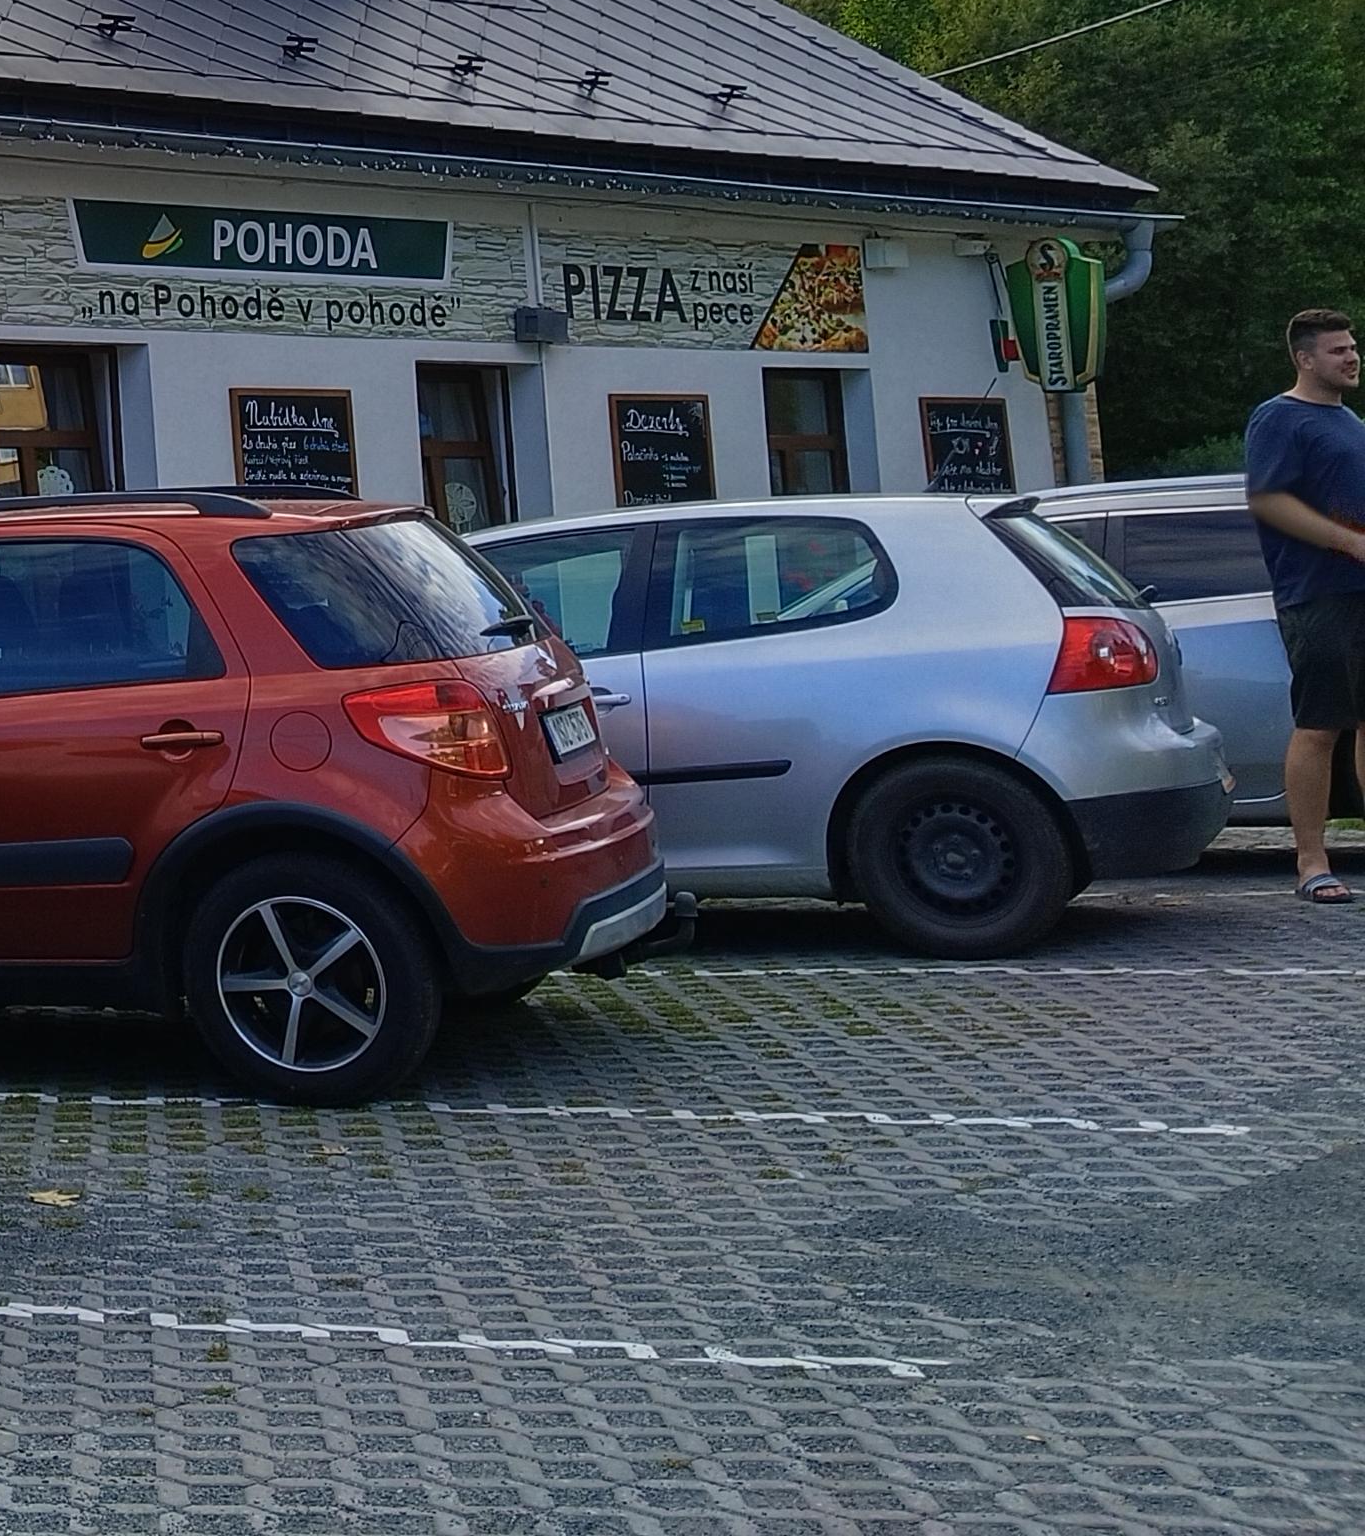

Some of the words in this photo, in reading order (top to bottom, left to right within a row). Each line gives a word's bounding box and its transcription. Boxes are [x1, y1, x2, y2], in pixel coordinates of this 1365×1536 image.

[213, 219, 378, 269] POHODA
[154, 283, 285, 322] Pohodě
[297, 297, 313, 322] v
[563, 264, 687, 323] PIZZA
[690, 269, 701, 291] z
[708, 262, 754, 293] naší
[694, 302, 753, 331] pece
[1043, 285, 1068, 386] STAROPRAMEN
